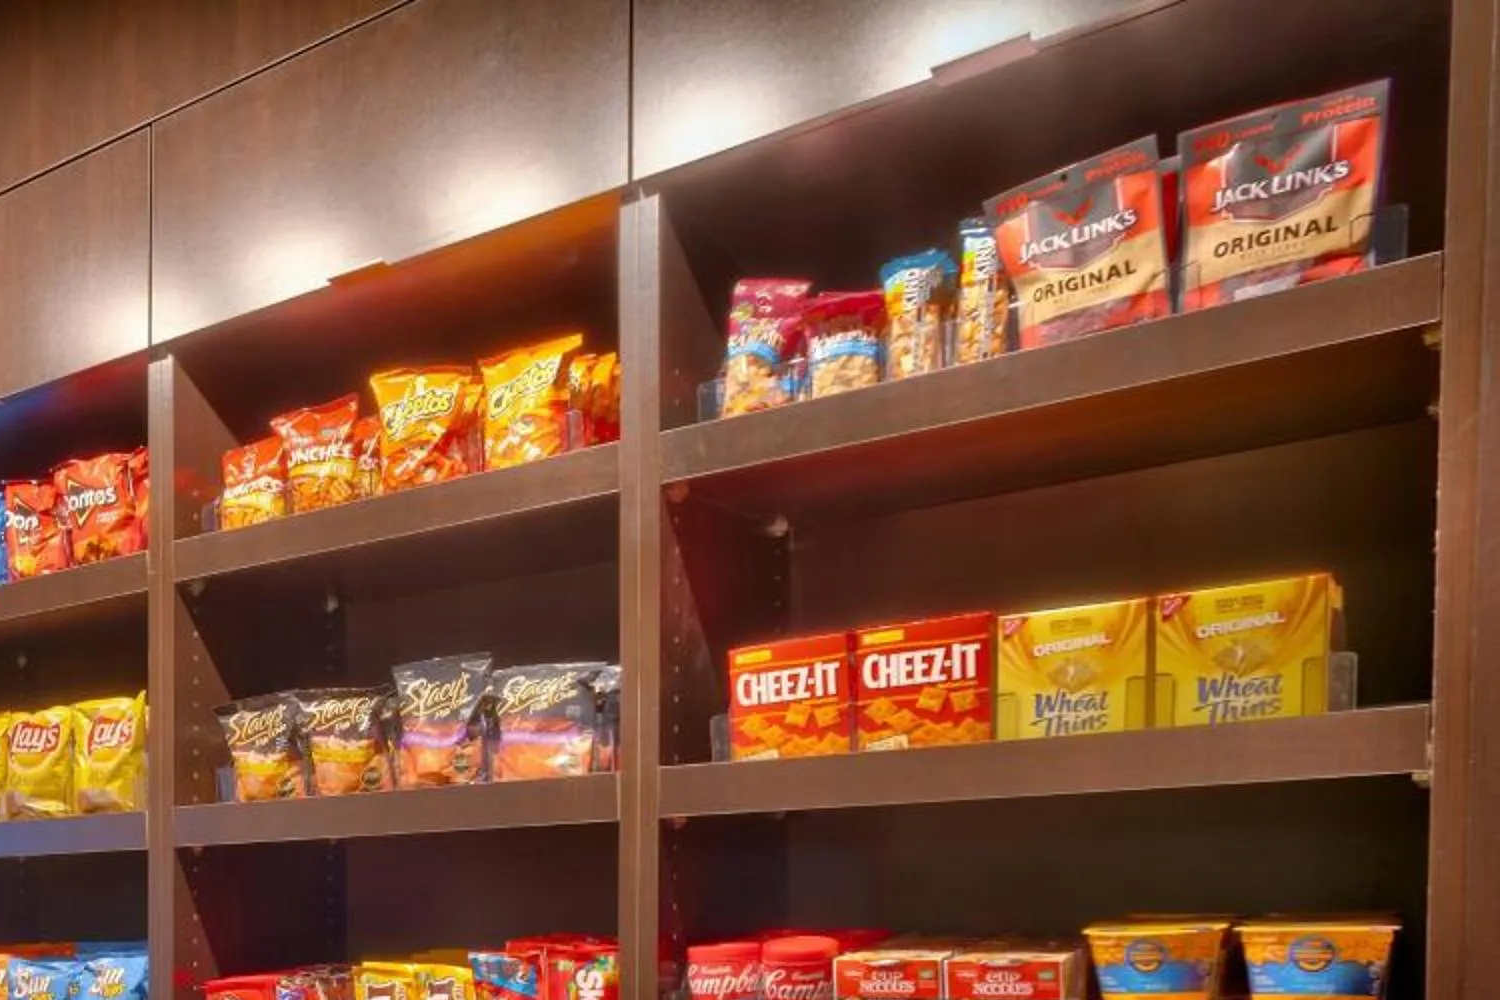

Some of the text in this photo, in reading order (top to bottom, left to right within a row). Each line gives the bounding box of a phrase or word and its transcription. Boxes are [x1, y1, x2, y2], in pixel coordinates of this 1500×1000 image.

[1213, 179, 1269, 211] JACK
[1019, 231, 1070, 264] JACK
[1213, 216, 1339, 259] ORIGINAL
[1032, 259, 1138, 303] ORIGINAL
[1196, 611, 1286, 640] ORIGINAL
[1032, 632, 1112, 657] ORIGINAL
[862, 643, 982, 690] CHEEZ-IT
[736, 661, 841, 707] CHEEZ-IT
[1196, 671, 1284, 705] Wheat
[1033, 688, 1109, 720] Wheat
[1192, 698, 1283, 731] Thins
[11, 721, 60, 753] Lay's
